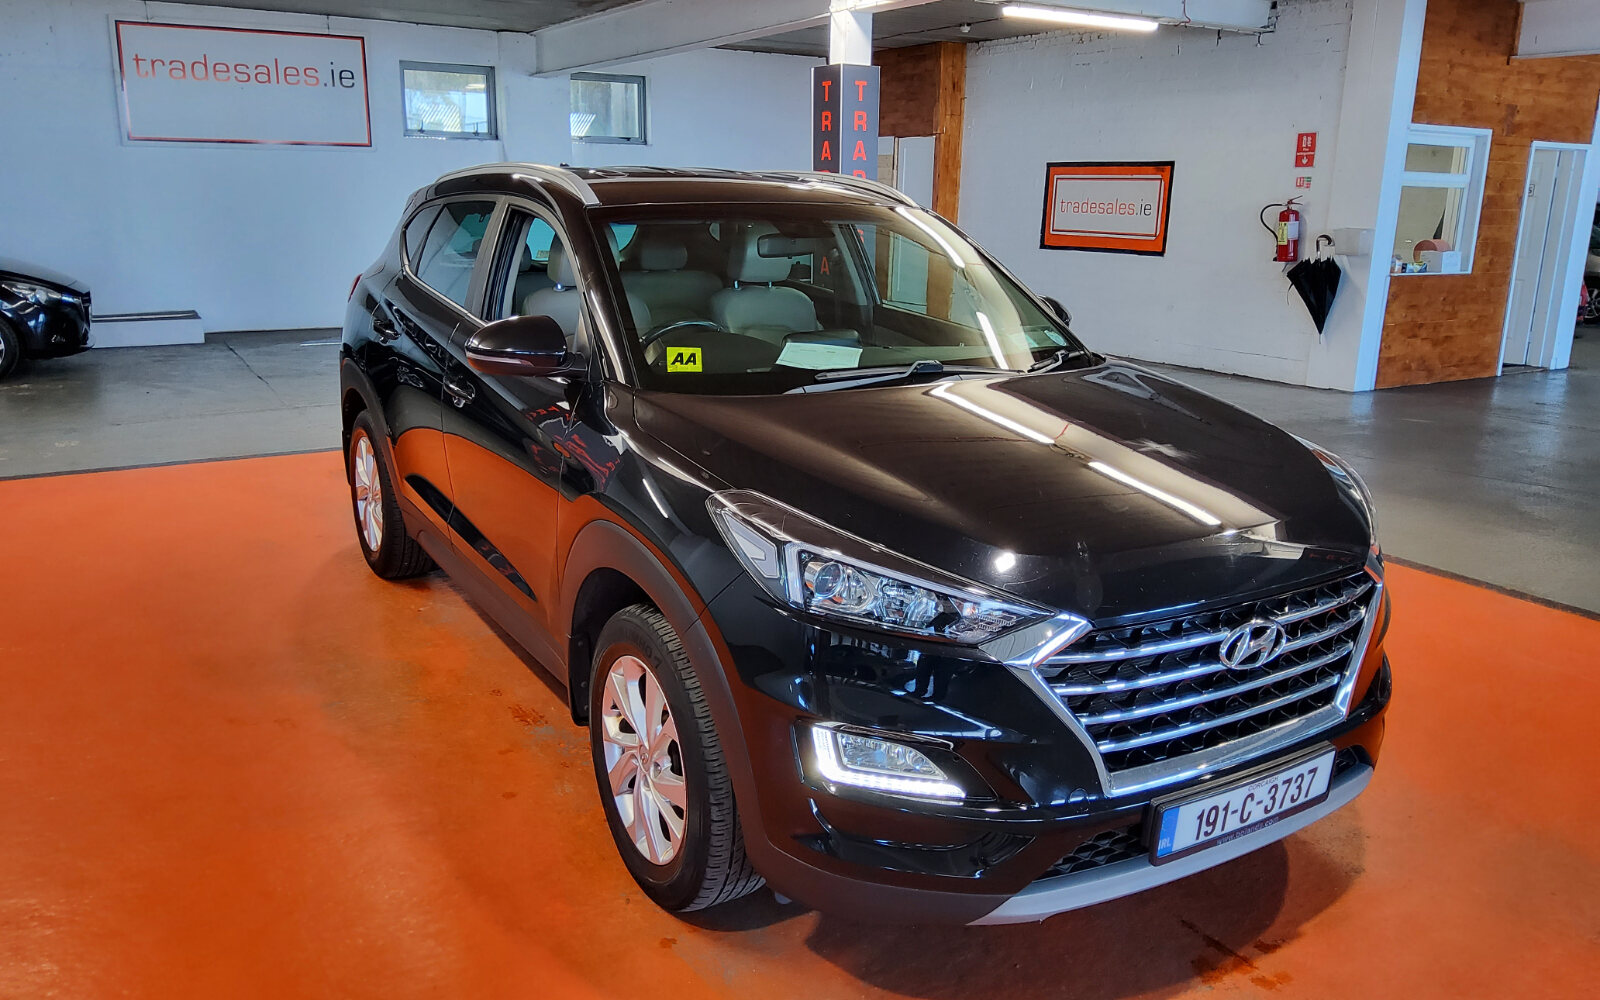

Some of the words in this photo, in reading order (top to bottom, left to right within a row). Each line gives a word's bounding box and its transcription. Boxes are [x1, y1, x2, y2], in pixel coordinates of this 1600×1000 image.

[133, 54, 355, 88] tradesales.ie
[1060, 198, 1152, 217] tradesales.ie
[671, 352, 697, 365] AA
[1195, 767, 1318, 841] 191-C-3737
